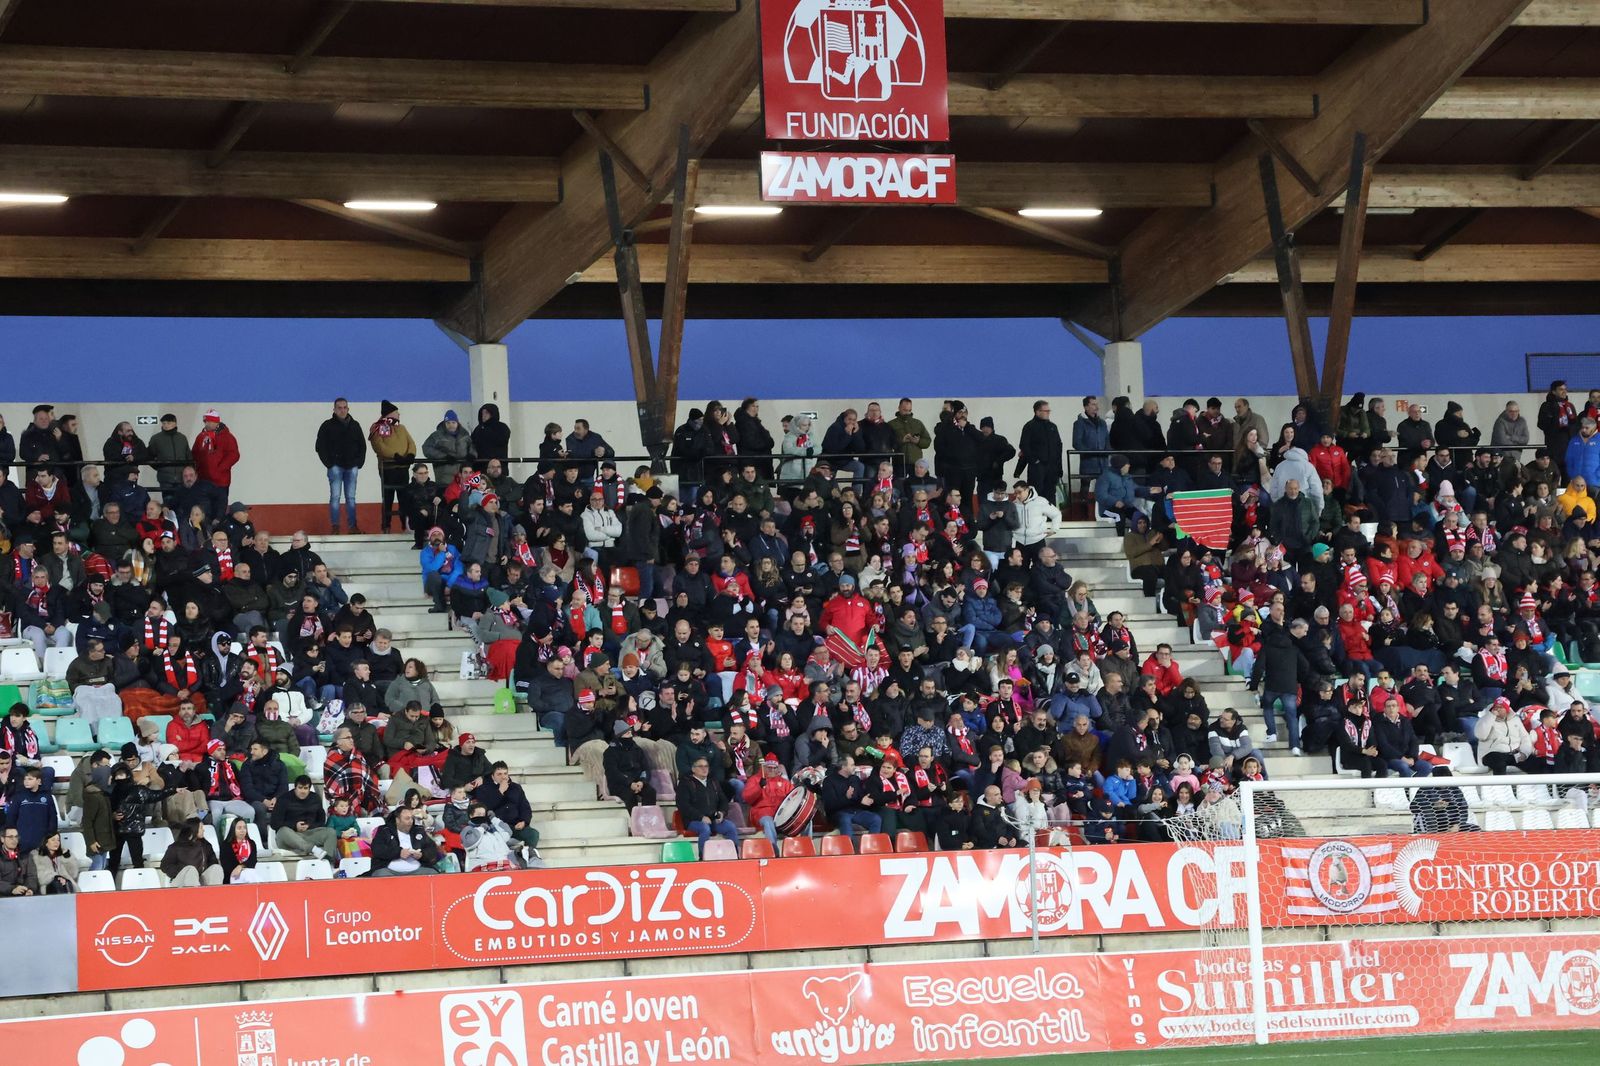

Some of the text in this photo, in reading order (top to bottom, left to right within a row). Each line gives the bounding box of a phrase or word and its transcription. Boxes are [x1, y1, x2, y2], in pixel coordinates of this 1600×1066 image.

[787, 108, 928, 139] FUNDACIÓN
[1321, 845, 1353, 856] FONDO
[1413, 862, 1540, 891] CENTRO
[879, 846, 1260, 938] ZAMORA CF
[1470, 888, 1600, 915] ROBERTO
[324, 908, 371, 925] Grupo
[95, 933, 155, 946] NISSAN
[325, 924, 422, 946] Leomotor
[474, 925, 726, 952] EMBUTIDOS Y JAMONES
[171, 944, 231, 955] DACIA
[1195, 958, 1284, 976] bodeas
[903, 967, 1083, 1008] Escuela
[1157, 960, 1405, 1012] Sumiller
[538, 990, 698, 1028] Carné Joven
[912, 1007, 1090, 1051] infantil
[1164, 1012, 1410, 1035] www.bodesdelsumiller.com
[541, 1027, 731, 1066] Castilla y León
